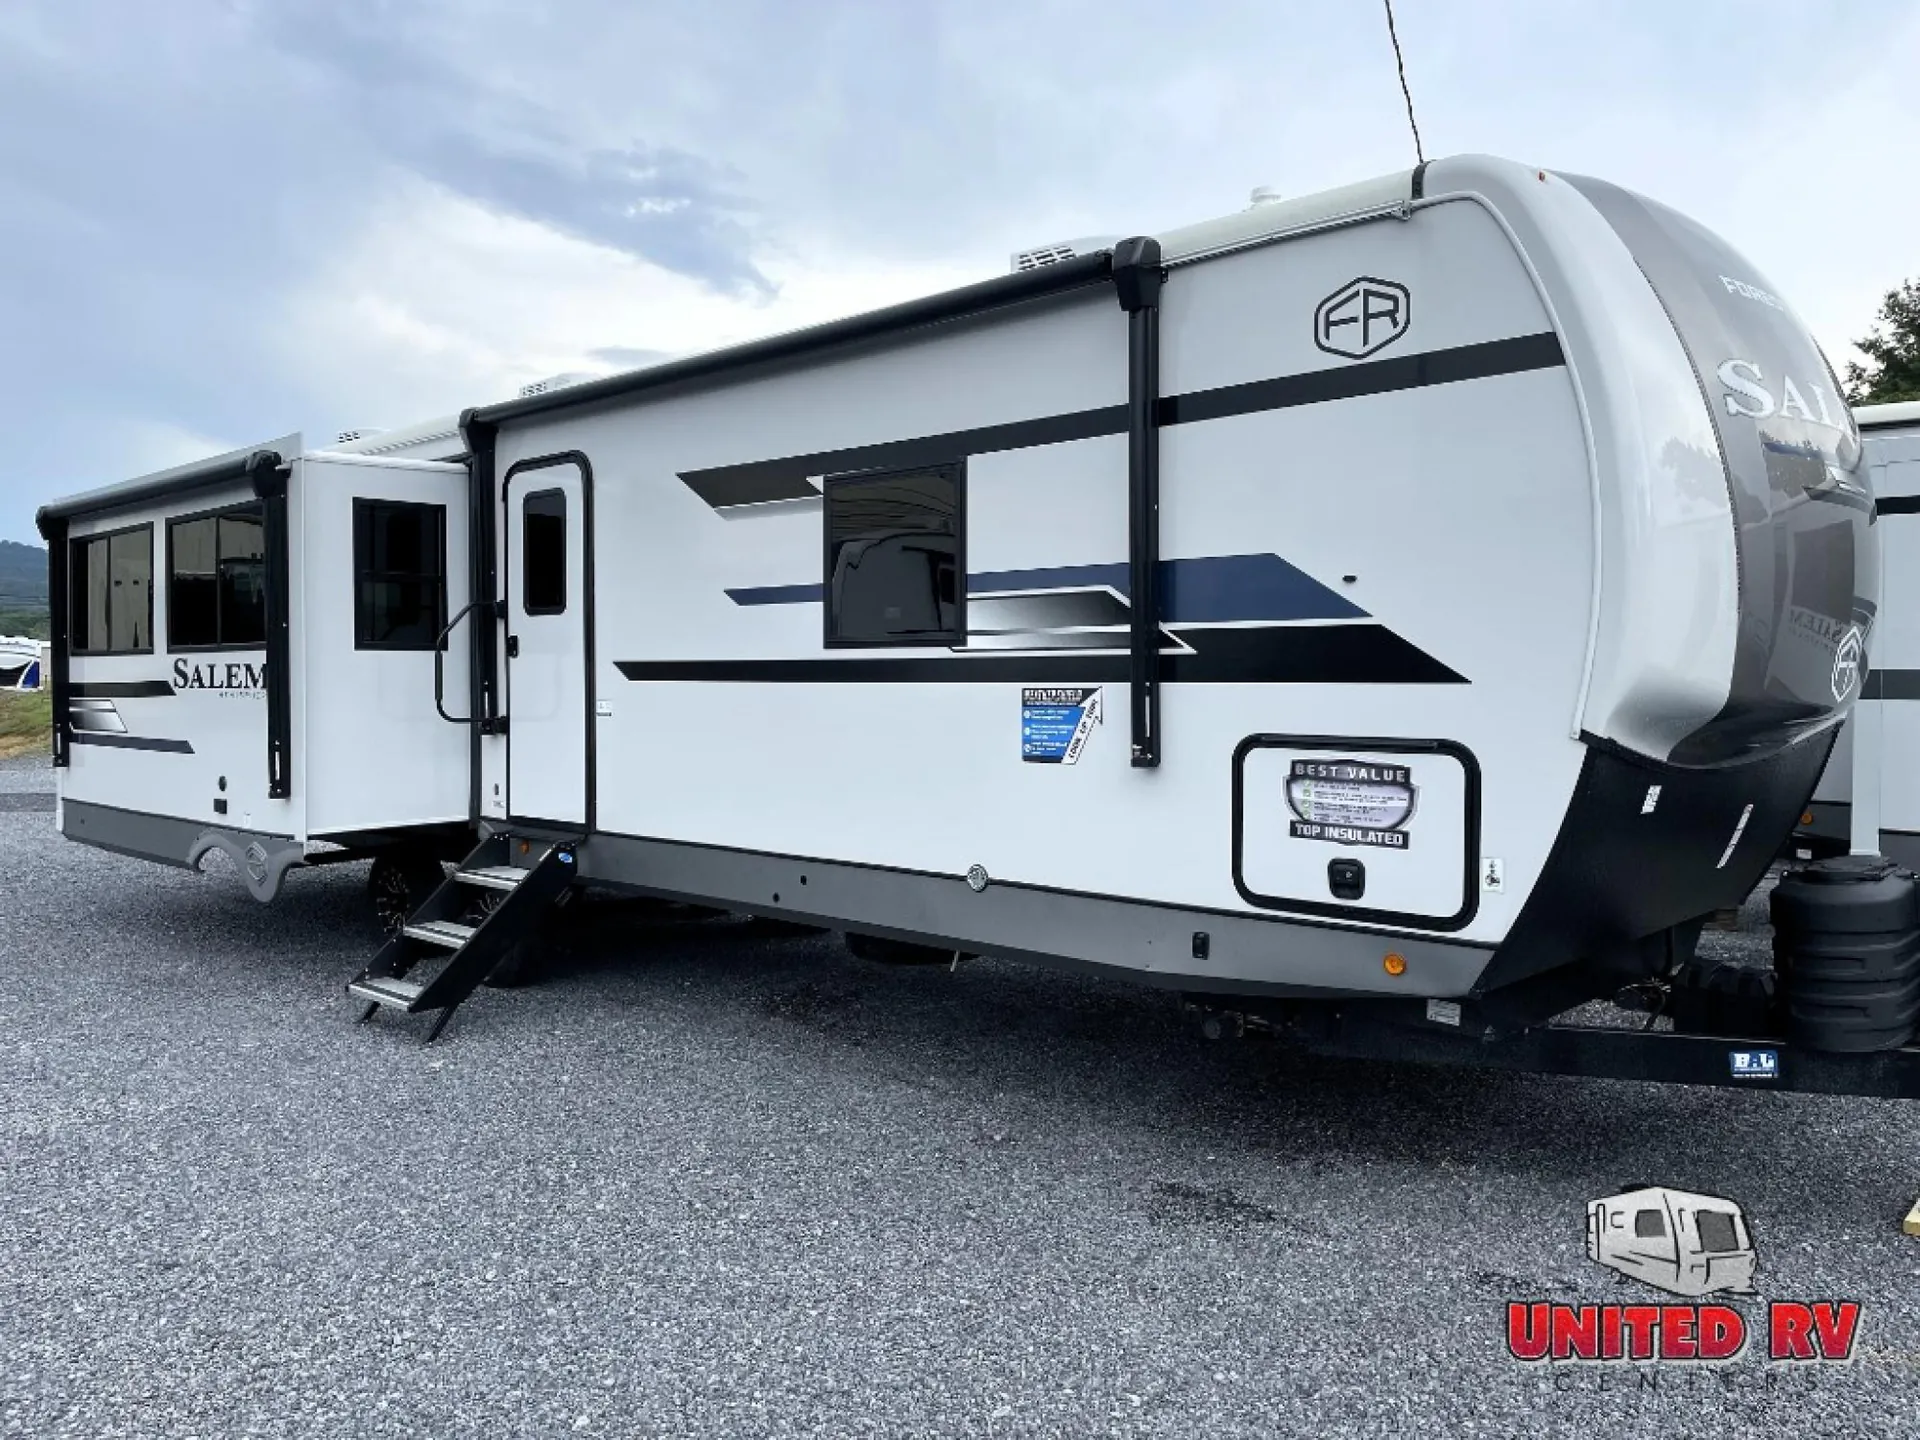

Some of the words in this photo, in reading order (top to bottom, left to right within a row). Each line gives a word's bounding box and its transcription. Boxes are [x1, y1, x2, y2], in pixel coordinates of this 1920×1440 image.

[173, 657, 268, 689] SALEM
[1294, 763, 1339, 778] BEST
[1347, 766, 1406, 783] VALUE
[1294, 823, 1321, 837] TOP
[1325, 826, 1404, 845] INSULATED
